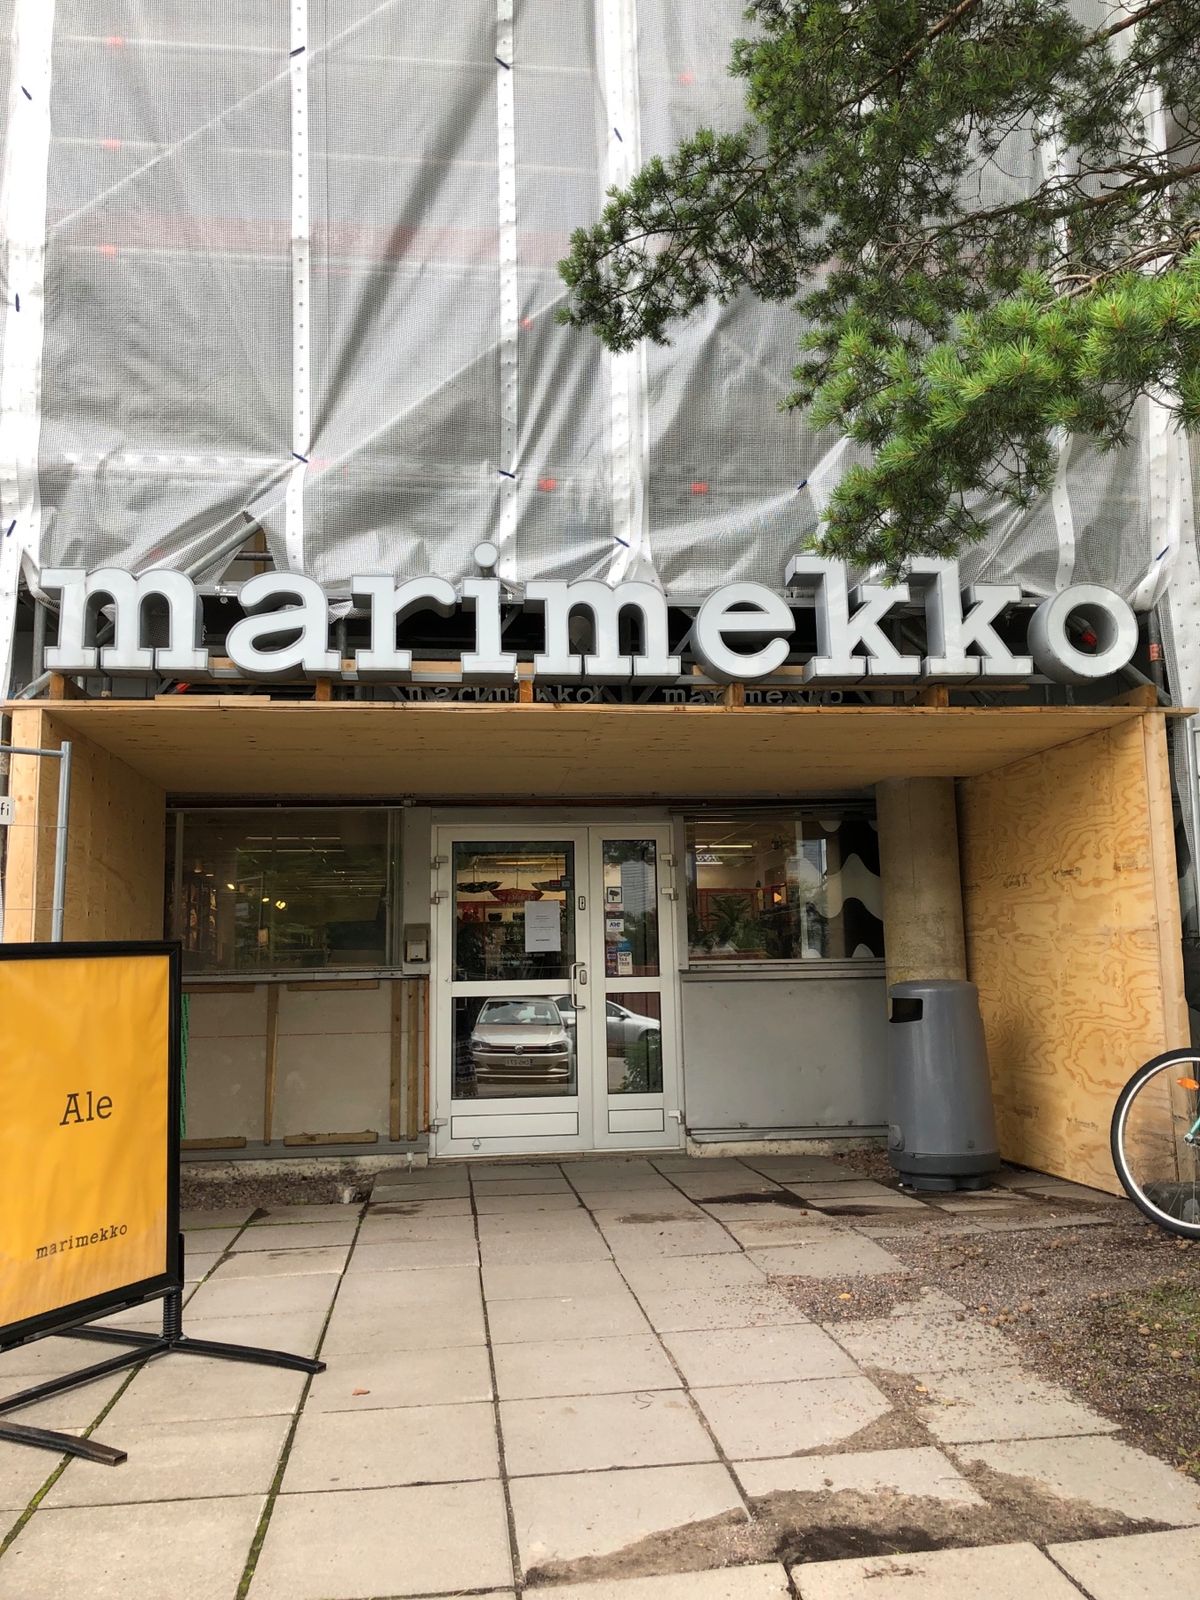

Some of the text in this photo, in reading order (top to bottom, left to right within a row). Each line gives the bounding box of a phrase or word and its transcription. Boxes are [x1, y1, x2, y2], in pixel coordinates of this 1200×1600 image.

[39, 542, 1139, 684] marimekko
[59, 1090, 113, 1126] Ale
[36, 1223, 128, 1260] marimekko
